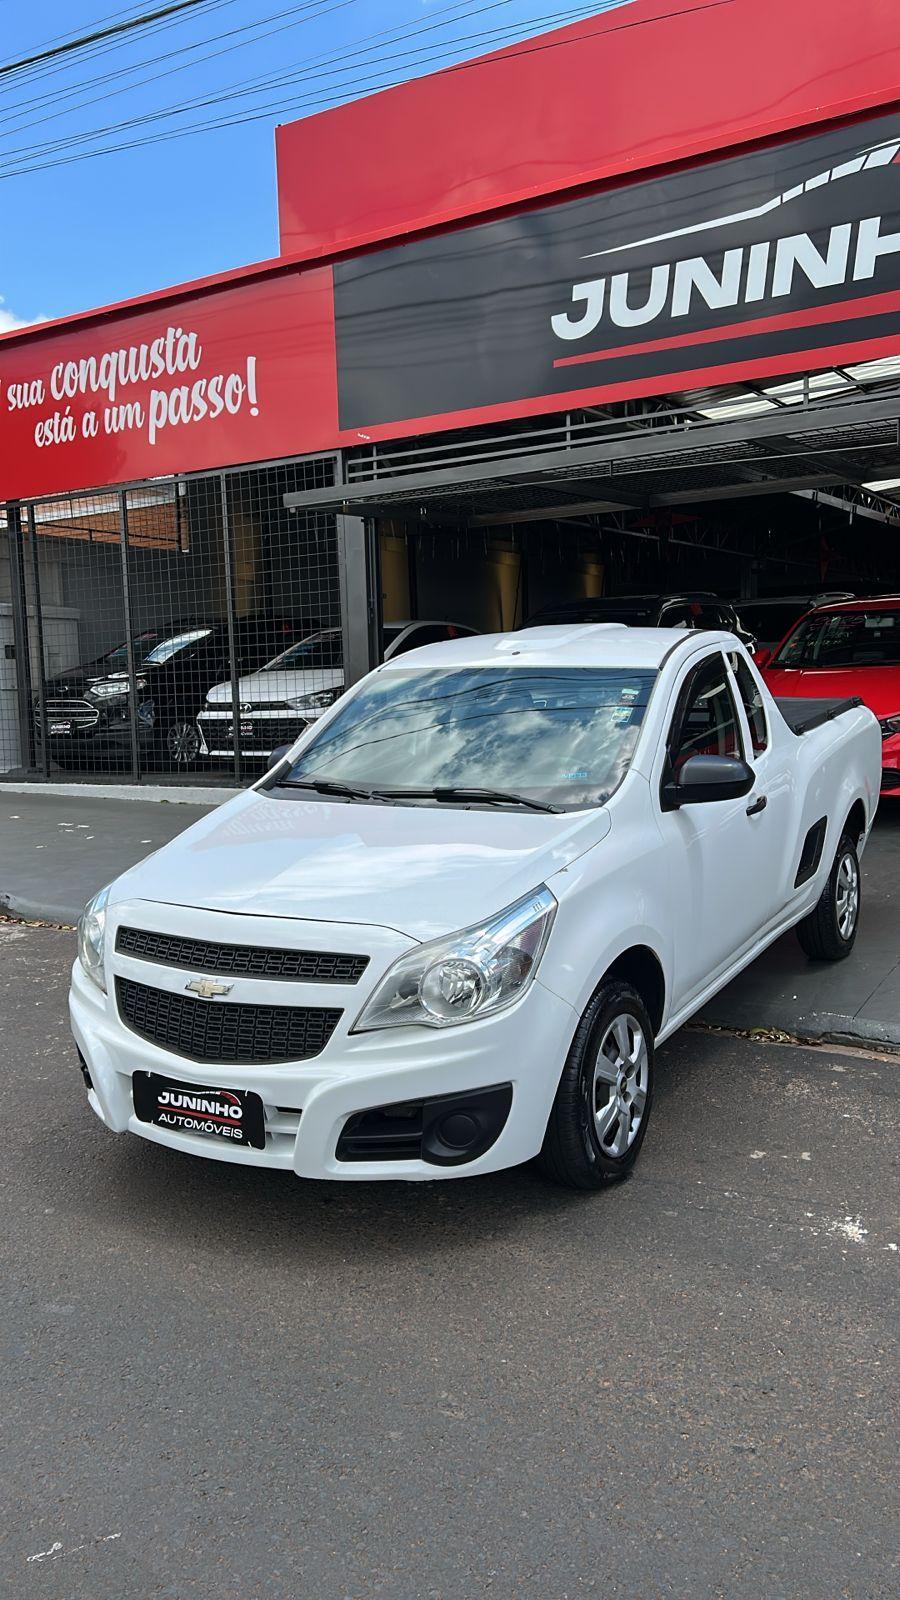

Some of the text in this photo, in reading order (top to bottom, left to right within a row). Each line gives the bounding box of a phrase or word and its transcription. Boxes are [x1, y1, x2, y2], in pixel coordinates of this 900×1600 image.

[7, 327, 202, 412] sua conquista
[34, 356, 259, 448] está a um passo!
[157, 1091, 243, 1119] JUNINHO
[158, 1113, 243, 1139] AUTOMÓVEIS
